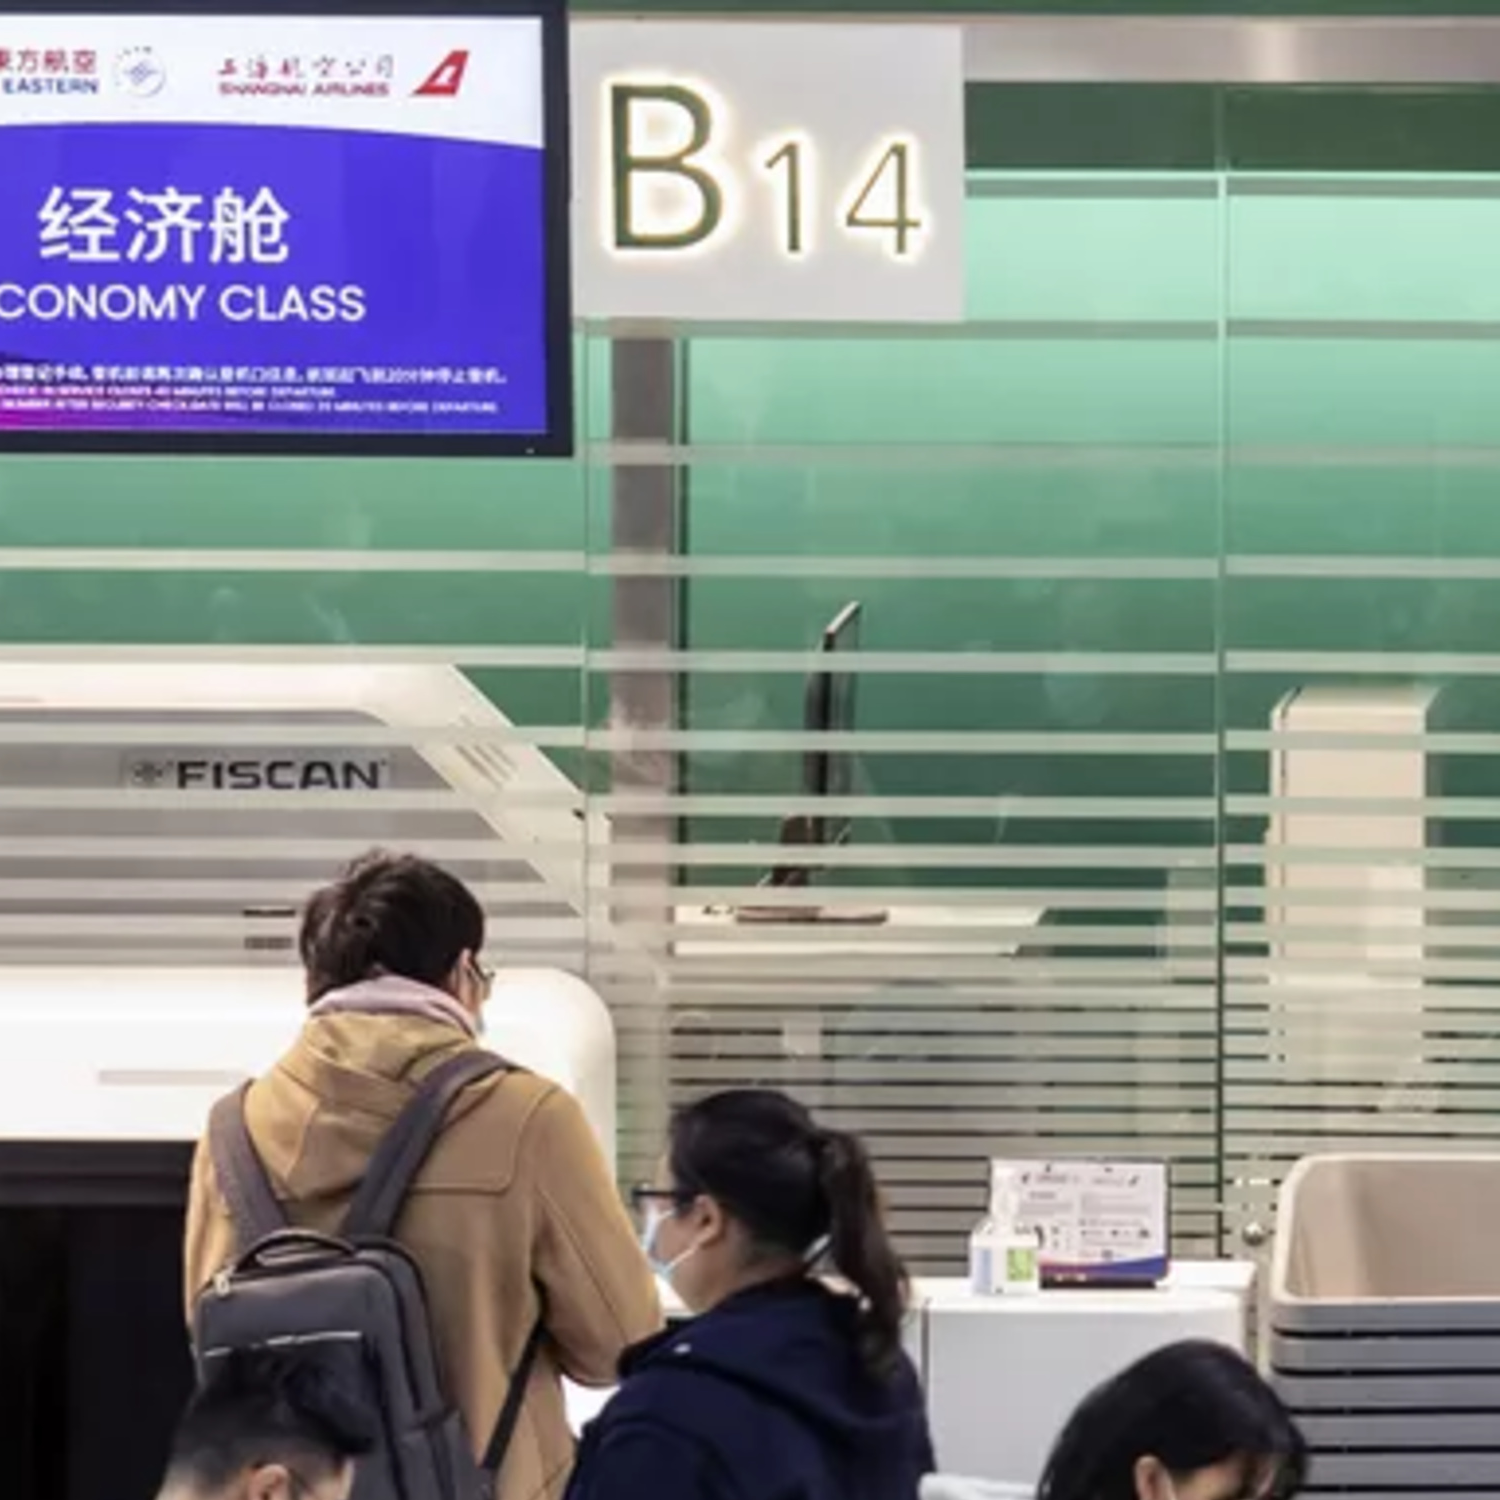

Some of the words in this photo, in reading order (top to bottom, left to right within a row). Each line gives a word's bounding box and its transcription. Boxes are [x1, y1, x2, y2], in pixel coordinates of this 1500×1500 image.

[3, 78, 99, 95] EASTERN
[219, 82, 307, 97] SHANGHAI
[313, 82, 390, 97] AIRLINES
[38, 186, 290, 263] 经济舱
[219, 284, 366, 322] CLASS
[177, 761, 379, 790] FISCAN
